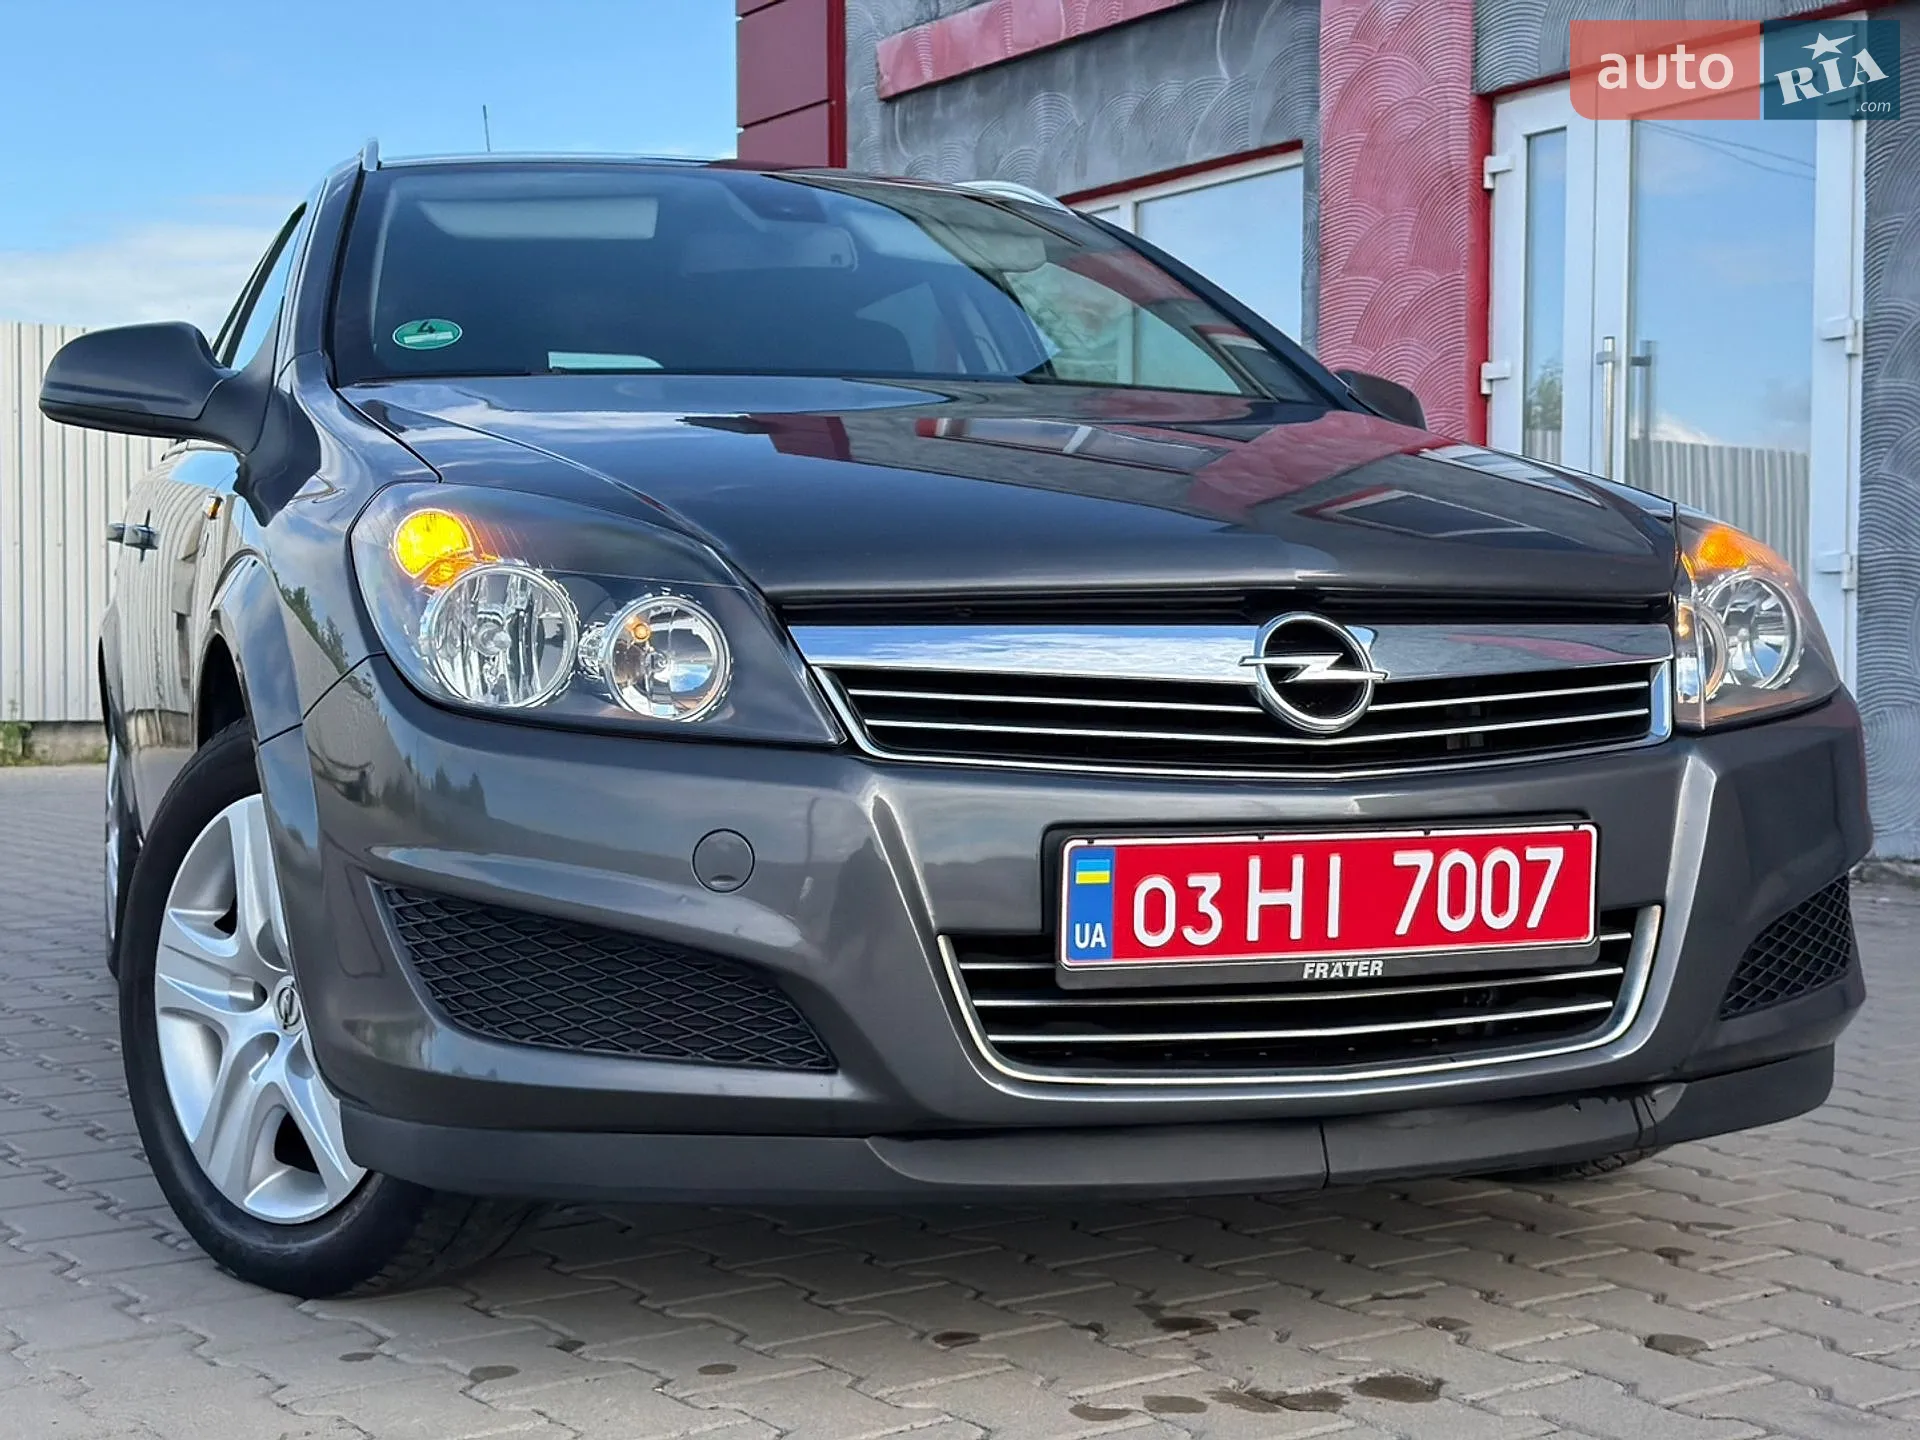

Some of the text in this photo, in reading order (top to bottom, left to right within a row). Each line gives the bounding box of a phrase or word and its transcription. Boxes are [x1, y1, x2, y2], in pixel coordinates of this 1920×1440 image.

[1133, 846, 1564, 947] 03 HI 7007
[1074, 922, 1107, 948] UA
